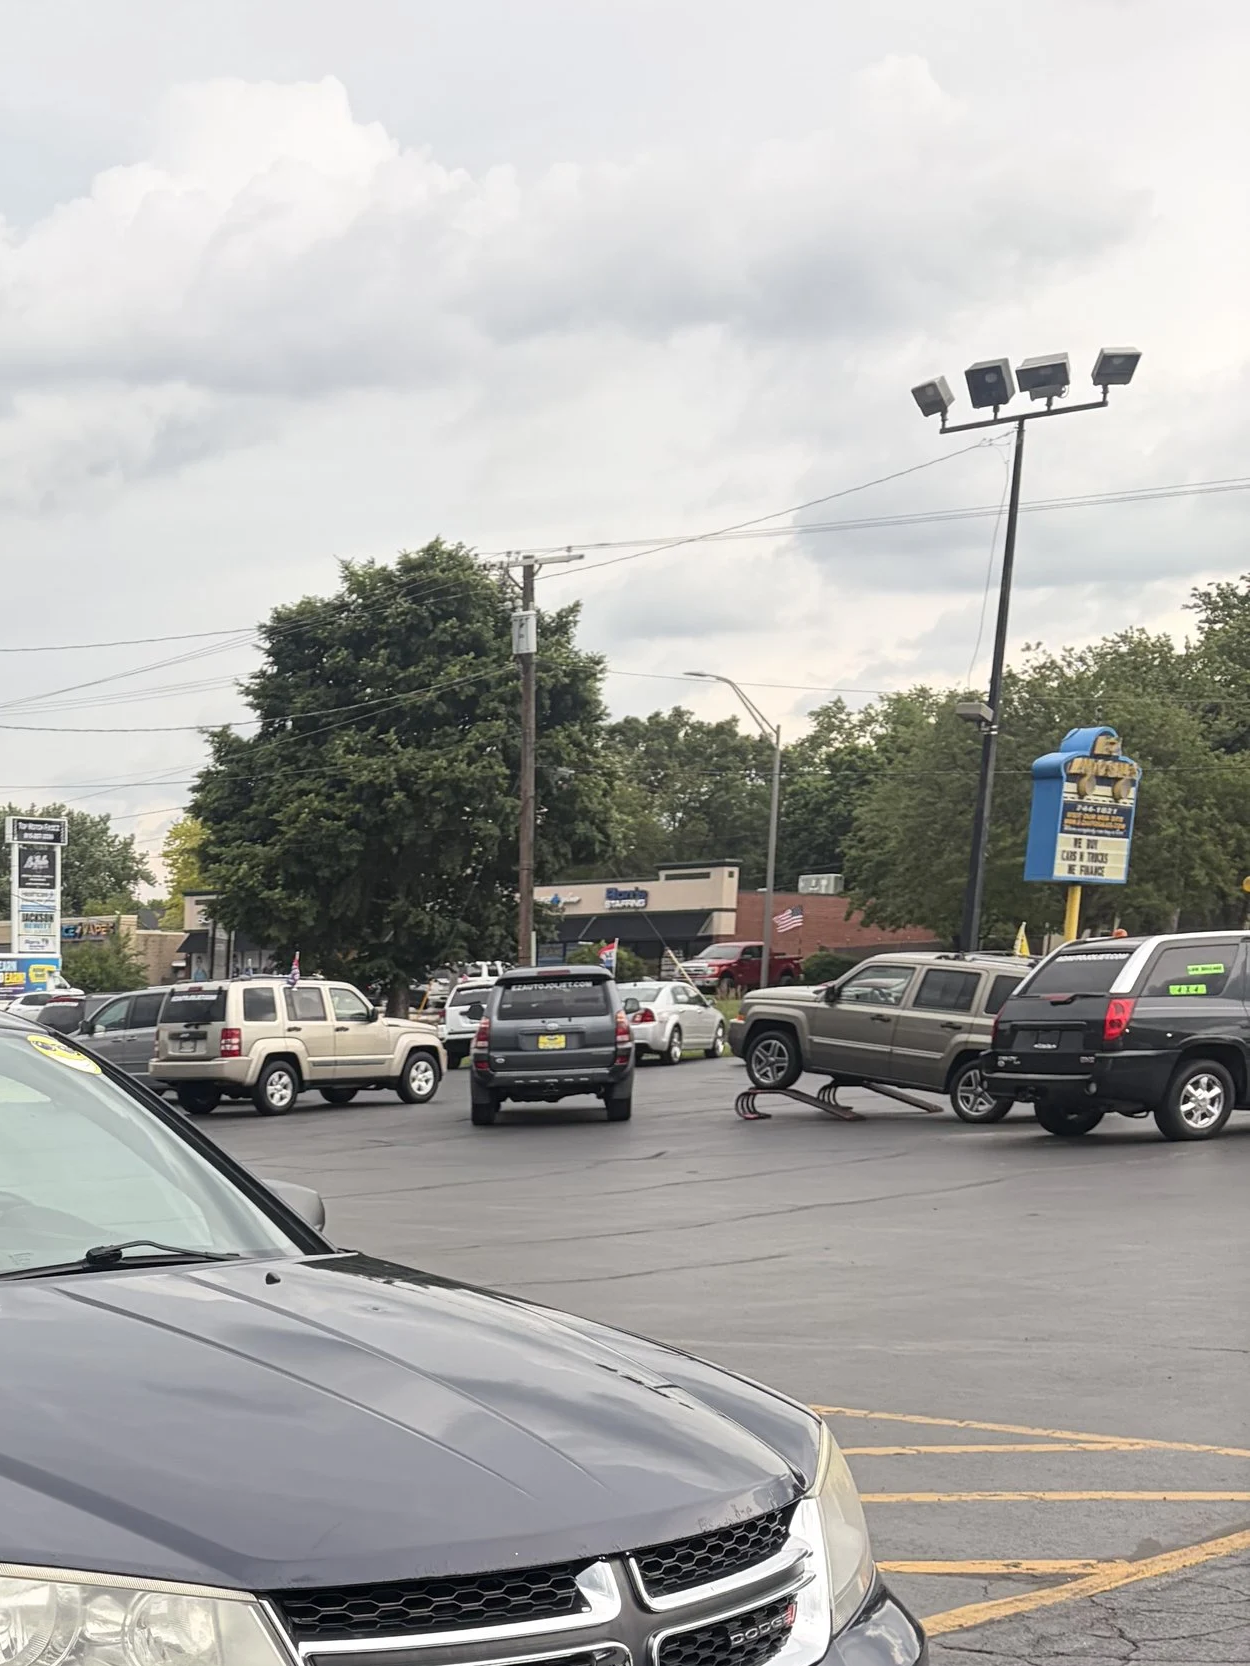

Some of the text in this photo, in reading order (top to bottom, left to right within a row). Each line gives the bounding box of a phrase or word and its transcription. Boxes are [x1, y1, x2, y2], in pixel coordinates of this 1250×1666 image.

[1073, 837, 1099, 850] WE BUY
[1061, 849, 1077, 862] CARS
[1087, 852, 1109, 865] TRUCKS
[1067, 864, 1105, 877] WE FINANCE
[21, 912, 55, 923] JACKSON
[511, 981, 593, 992] EZAUTOJOLIET.COM
